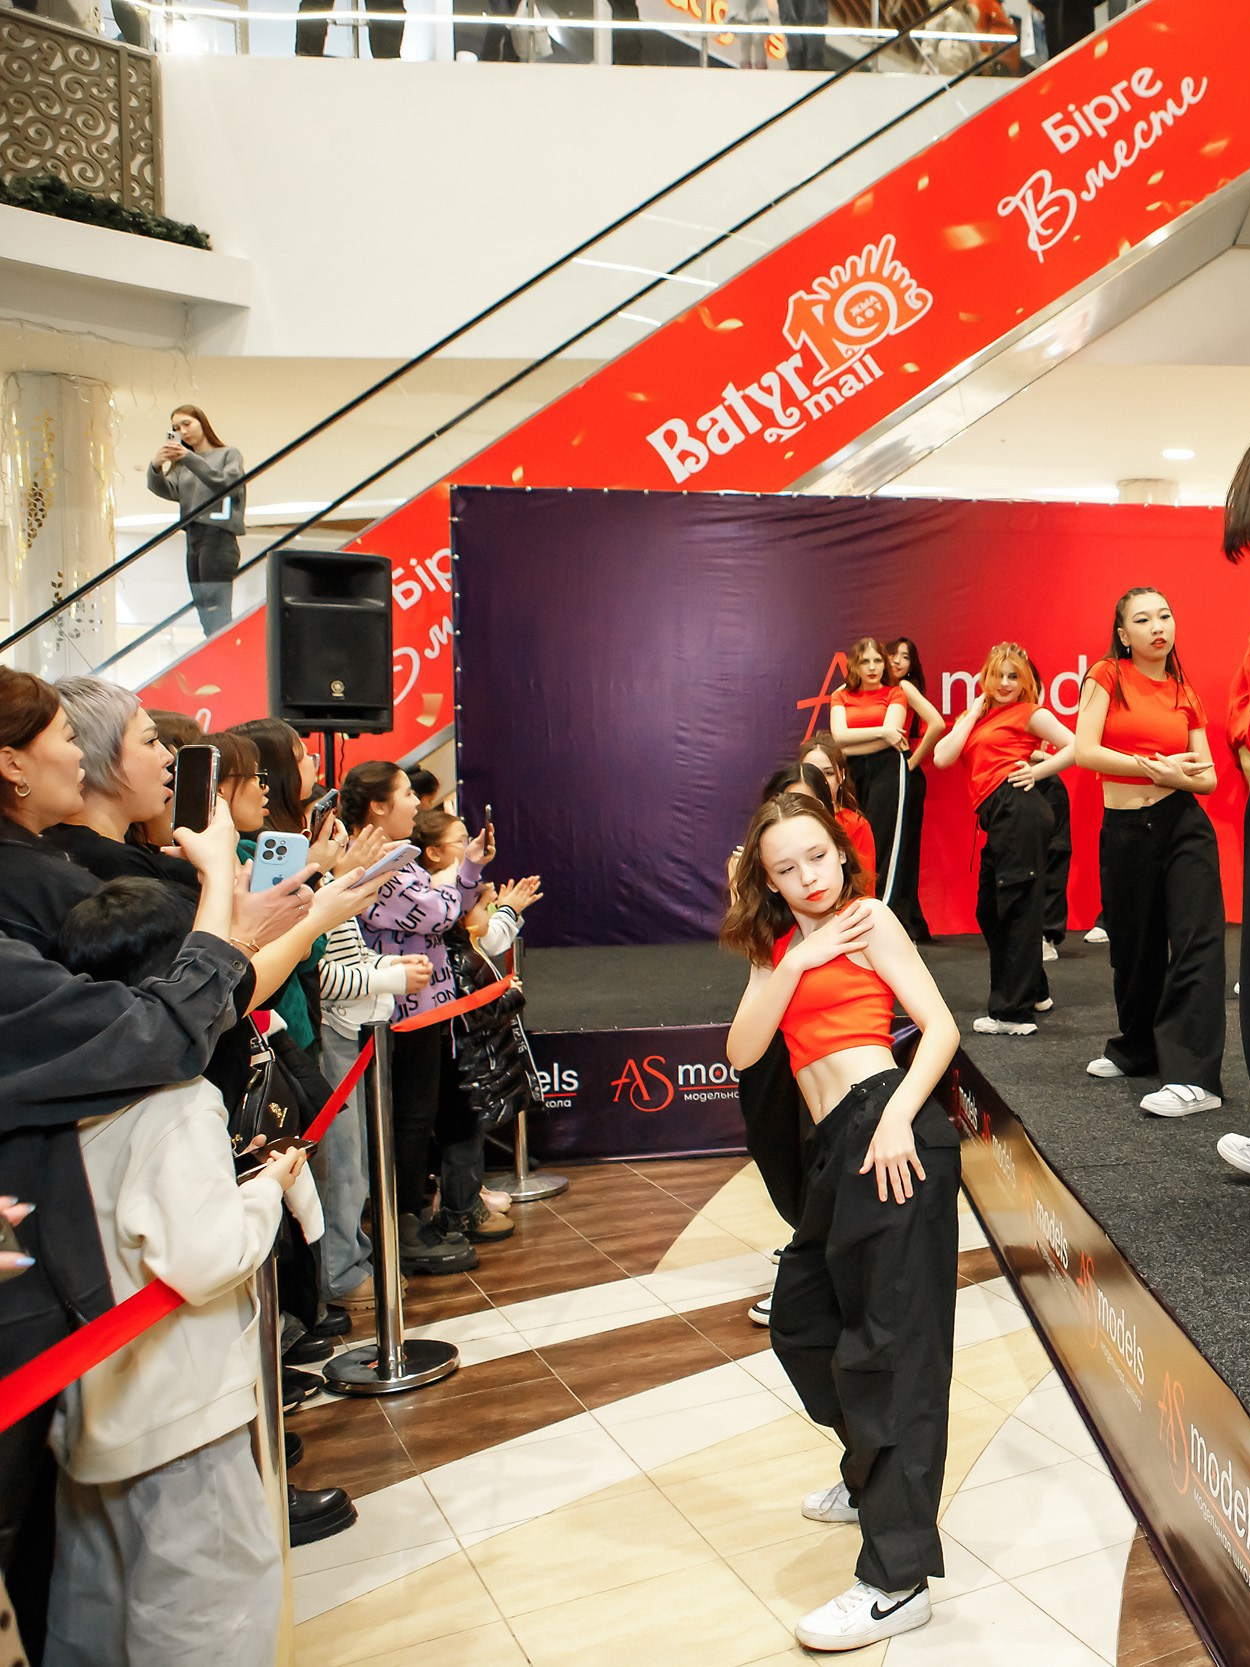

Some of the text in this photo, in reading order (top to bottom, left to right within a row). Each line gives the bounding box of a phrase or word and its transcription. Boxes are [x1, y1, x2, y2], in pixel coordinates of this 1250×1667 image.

[1041, 66, 1163, 154] Бірге
[997, 76, 1207, 263] Вместе
[645, 351, 811, 485] Batyr
[803, 355, 884, 424] mall
[610, 1055, 674, 1113] AS
[1035, 1198, 1069, 1270] models
[1098, 1289, 1145, 1386] models
